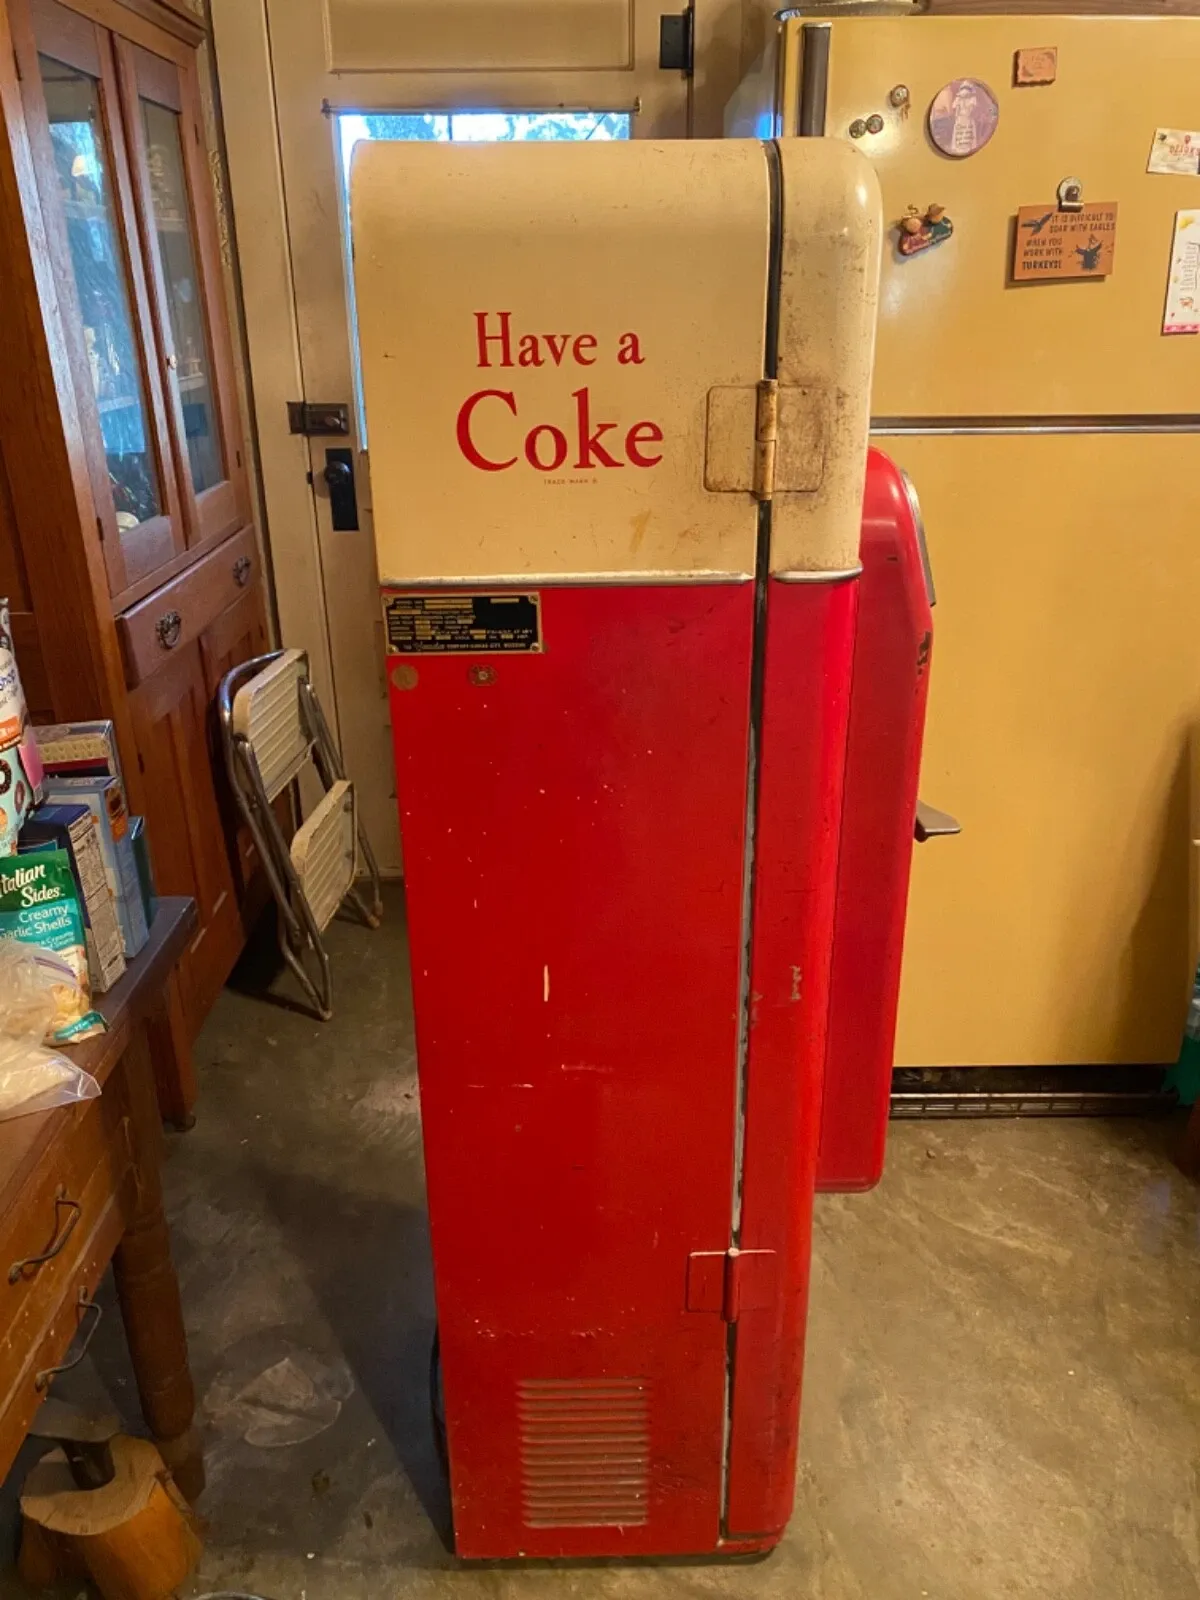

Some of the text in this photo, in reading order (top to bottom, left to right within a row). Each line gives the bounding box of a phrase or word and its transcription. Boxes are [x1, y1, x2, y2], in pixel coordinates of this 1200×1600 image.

[473, 312, 646, 368] Have a
[456, 387, 663, 472] Coke
[21, 884, 60, 908] Sides
[19, 905, 69, 923] Creamy
[0, 926, 33, 939] arlic
[34, 917, 72, 934] Shells
